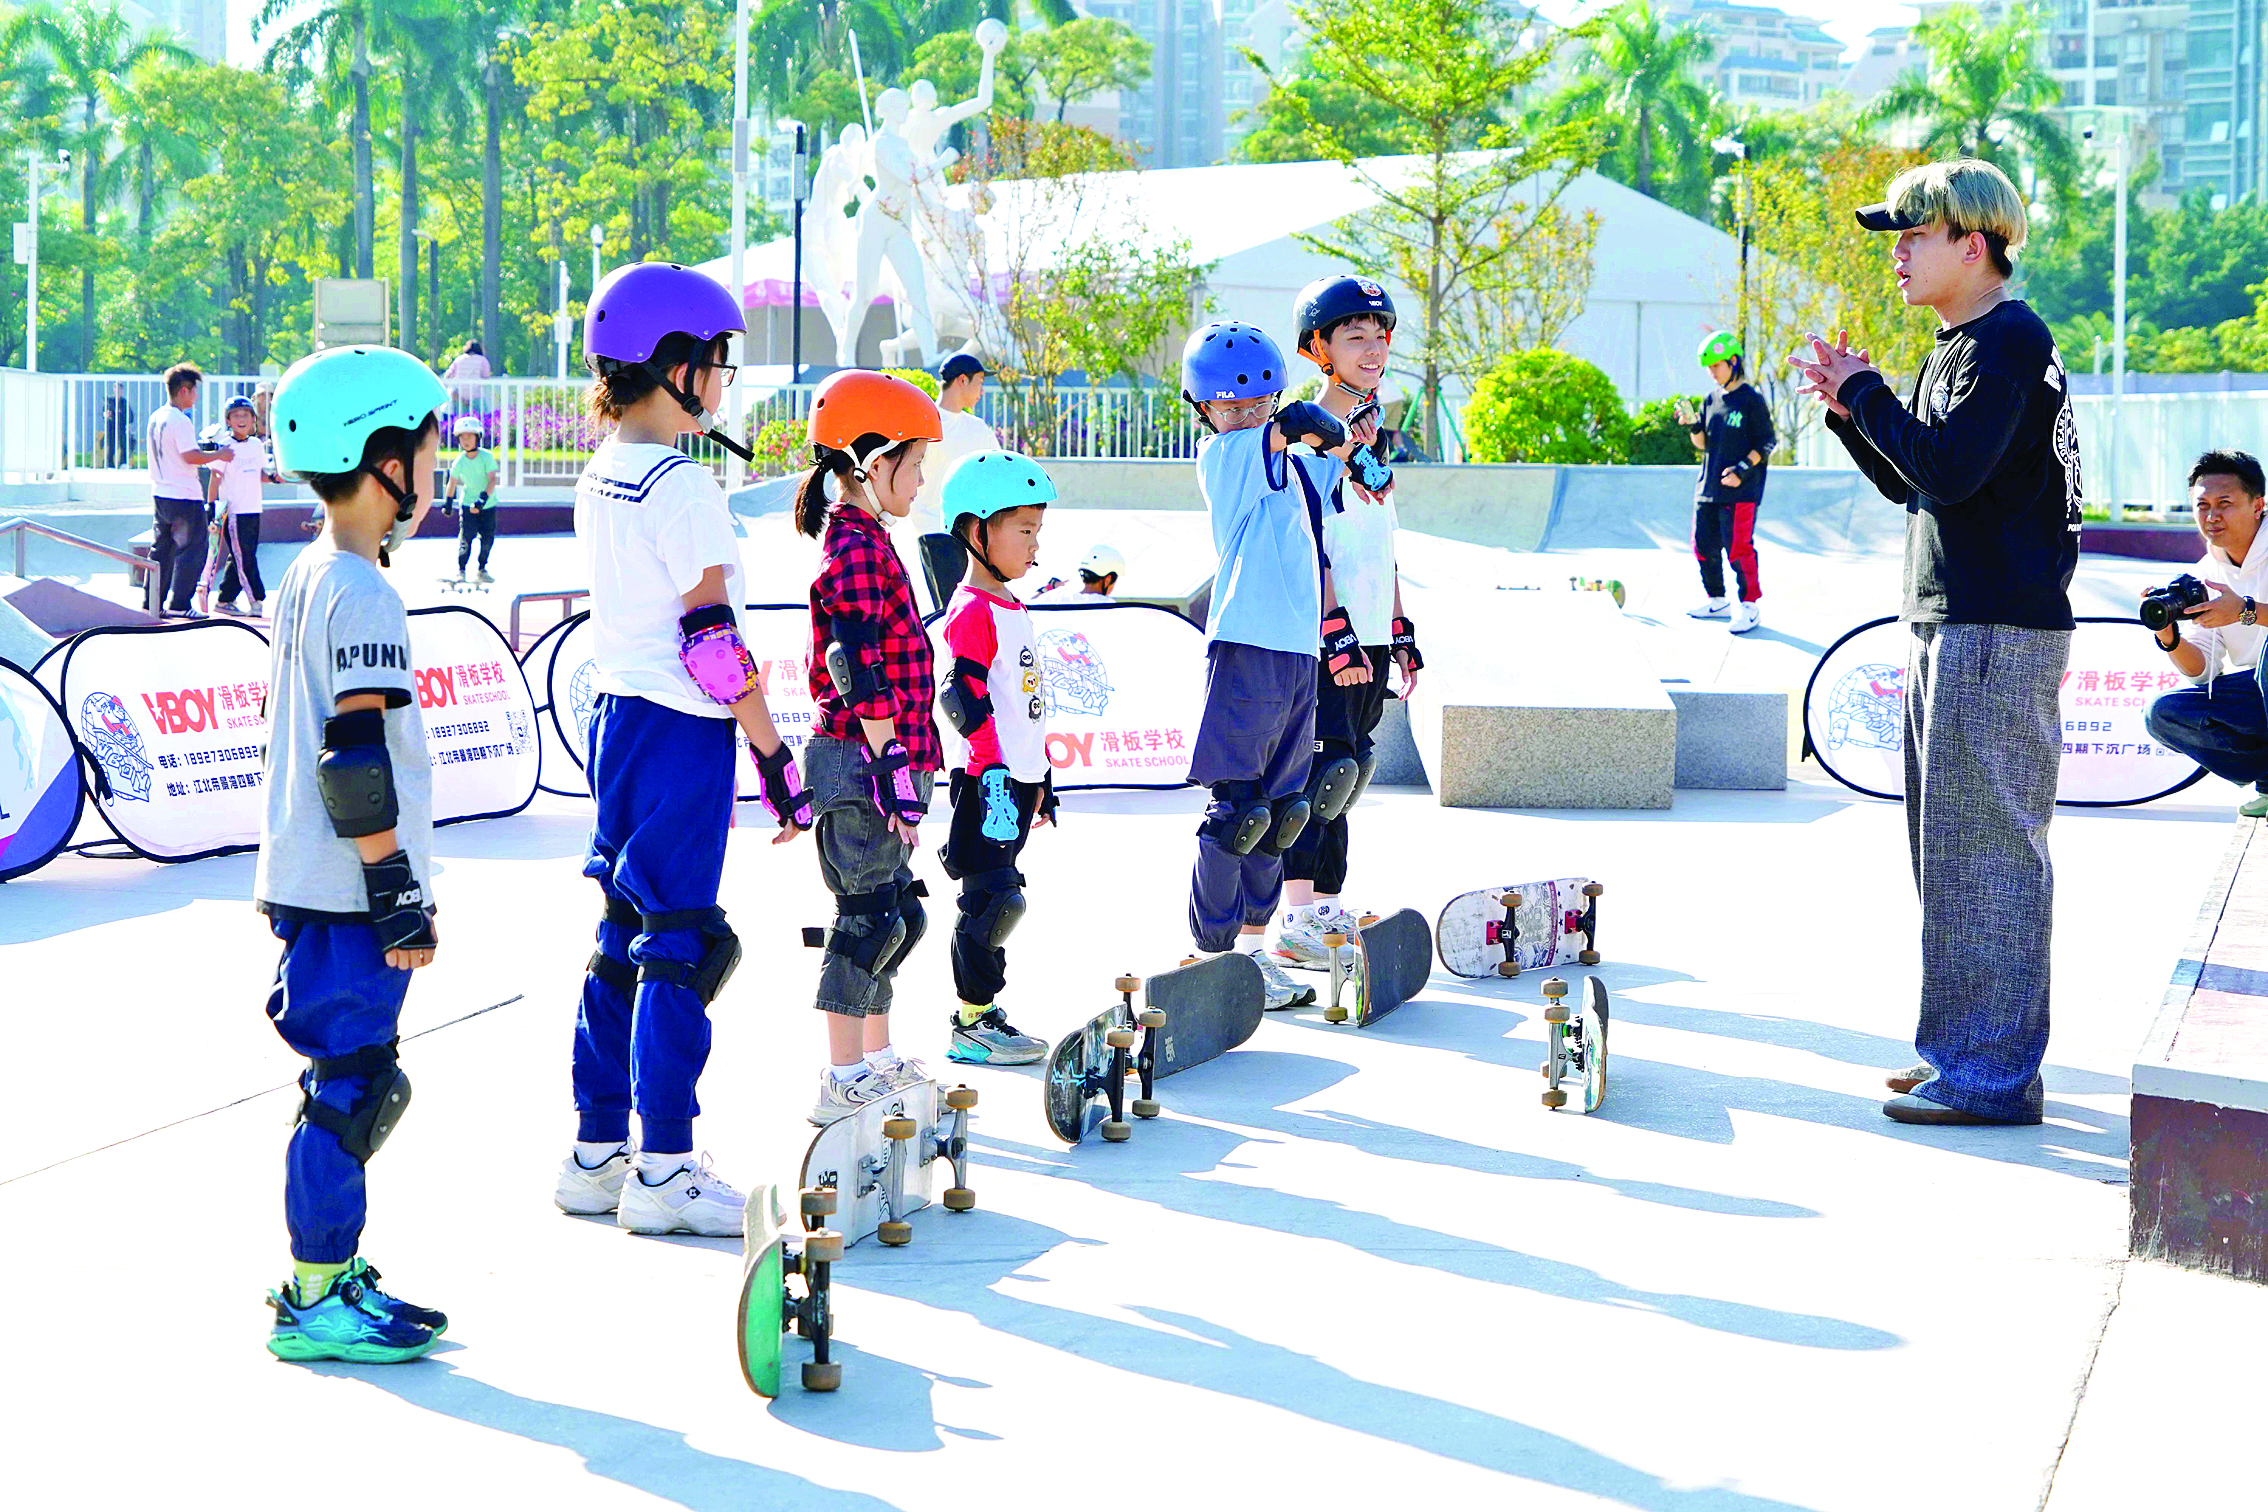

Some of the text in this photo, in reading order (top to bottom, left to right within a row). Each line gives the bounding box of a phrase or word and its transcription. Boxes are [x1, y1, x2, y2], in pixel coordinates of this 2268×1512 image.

[1216, 390, 1236, 399] FILA
[455, 660, 506, 689] 滑板学校
[2077, 670, 2181, 692] 滑板学校
[462, 690, 511, 706] SKATE SCHOOL
[2075, 697, 2119, 707] SKATE
[140, 687, 219, 735] VBOY
[226, 715, 253, 729] SKATE
[1100, 728, 1185, 753] 滑板学校
[1105, 754, 1190, 768] SKATE SCHOOL
[166, 771, 266, 797] 地址：江北帝景湾四期下
[395, 888, 422, 906] BOY
